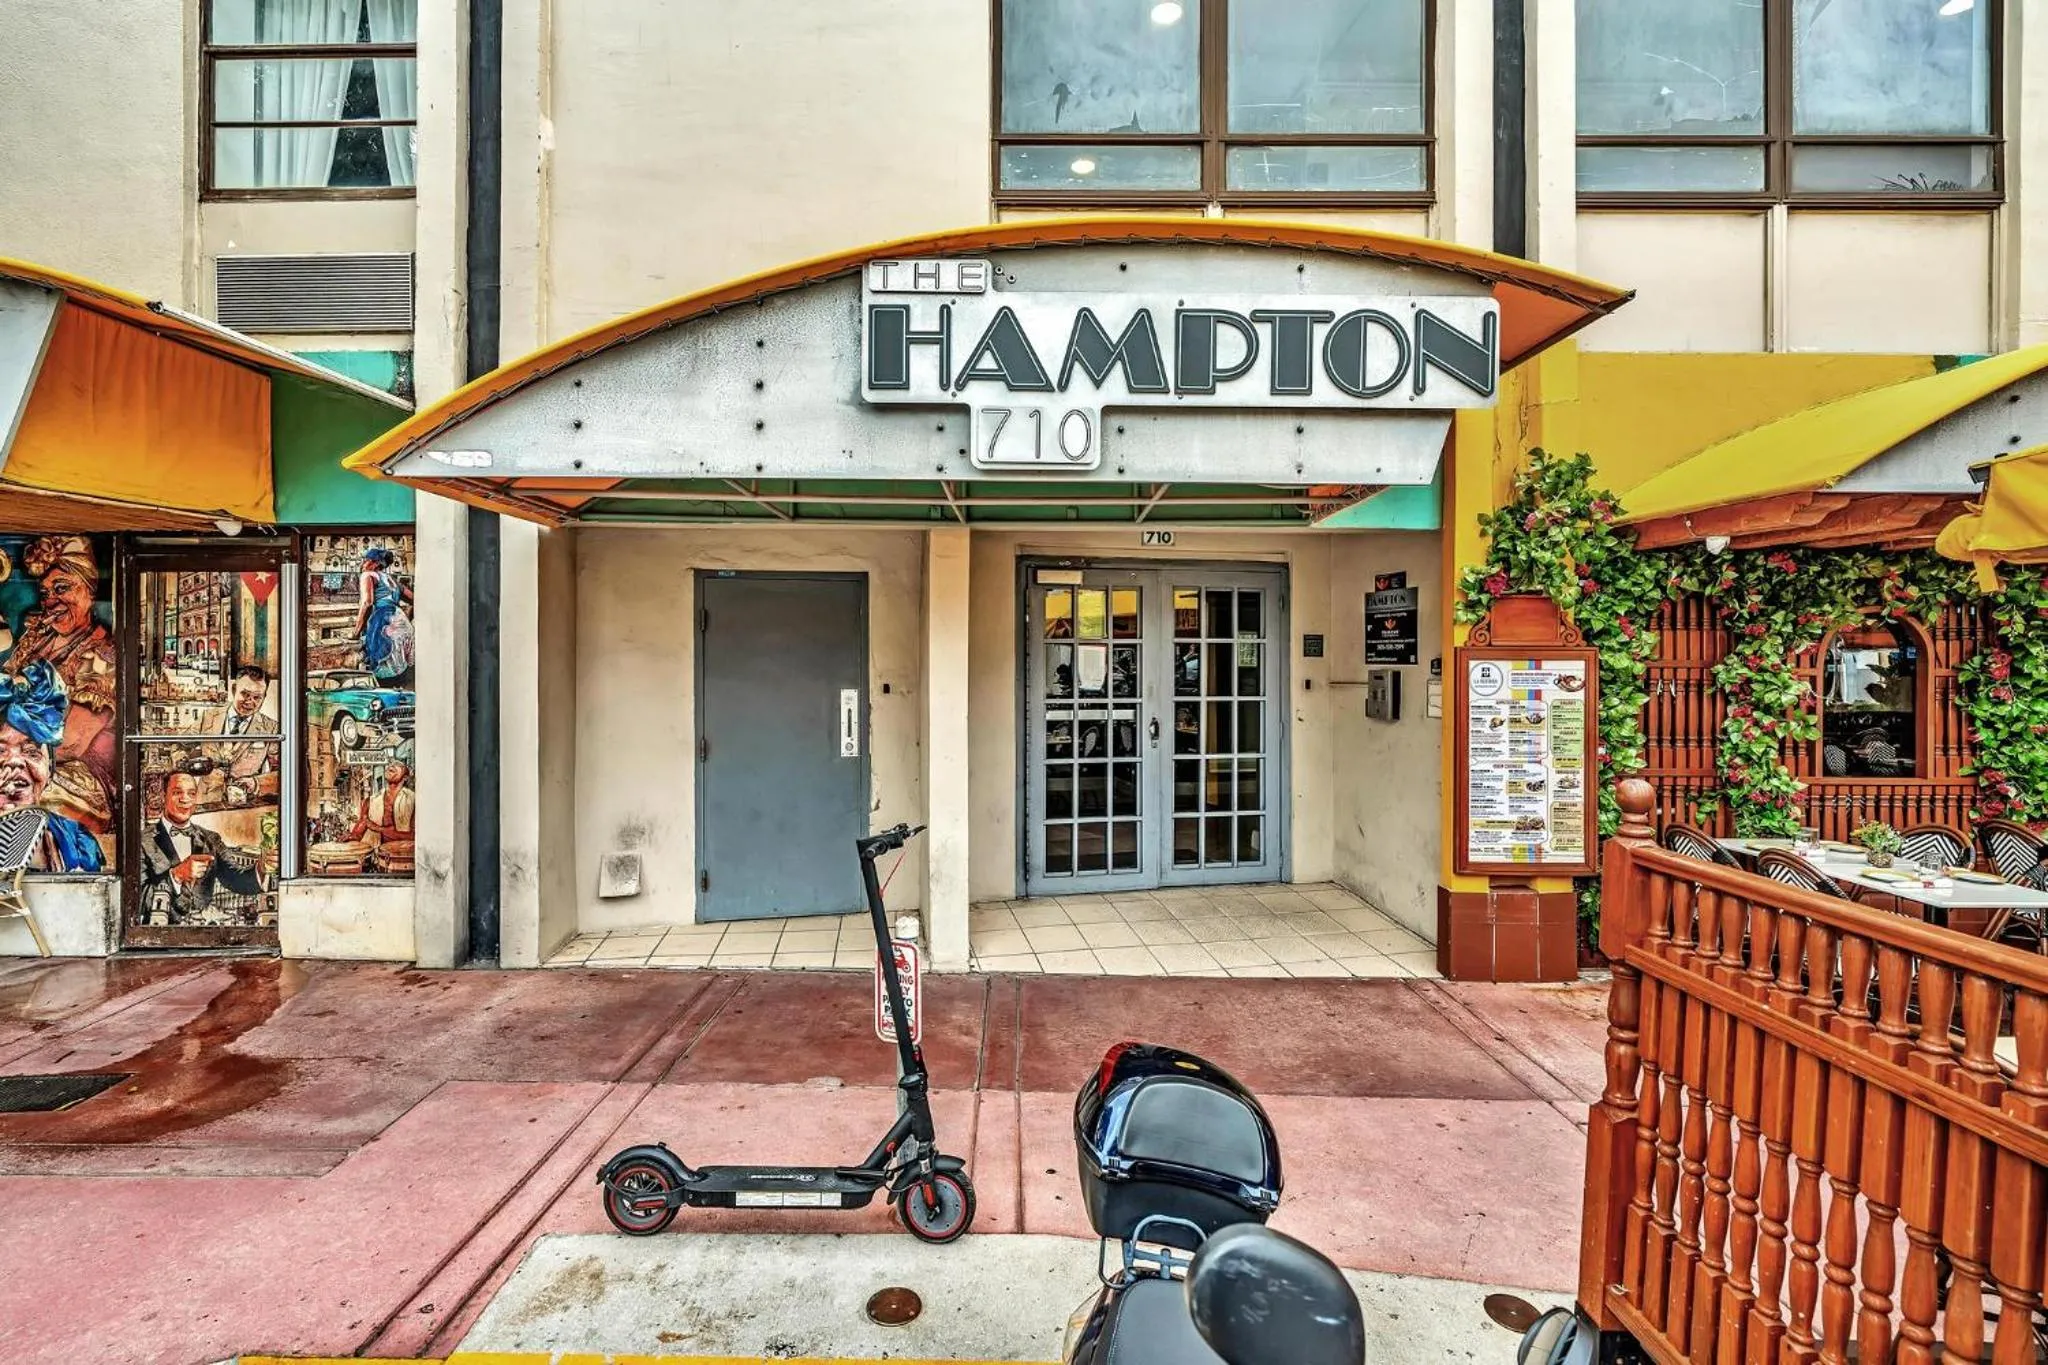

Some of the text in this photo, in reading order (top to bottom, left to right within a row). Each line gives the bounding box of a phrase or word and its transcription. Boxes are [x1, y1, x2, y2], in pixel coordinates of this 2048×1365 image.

[872, 262, 983, 291] THE
[868, 303, 1496, 399] HAMPTON
[981, 408, 1092, 462] 710
[1146, 531, 1172, 544] 710
